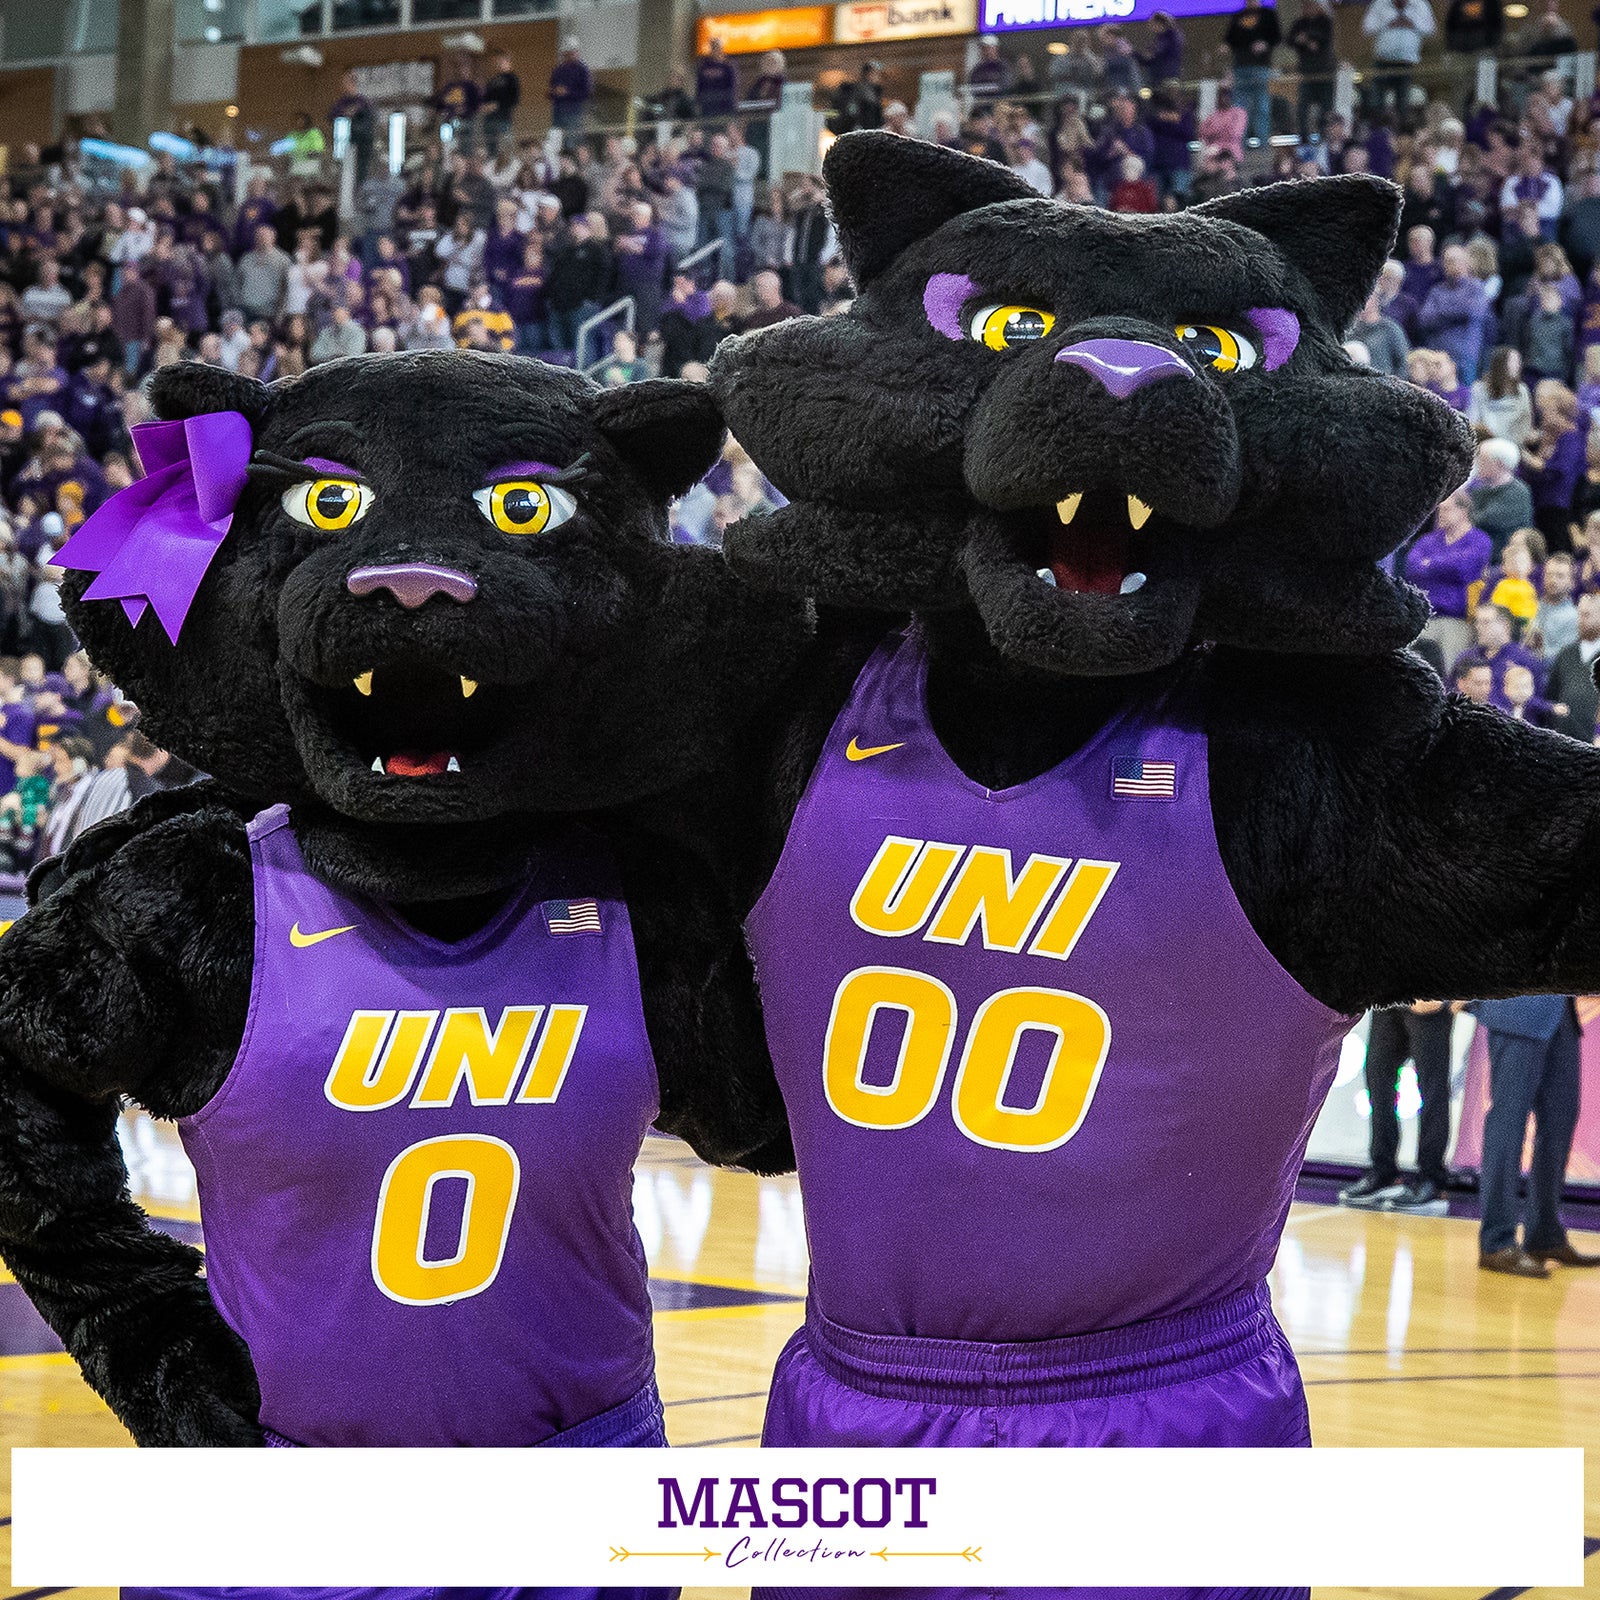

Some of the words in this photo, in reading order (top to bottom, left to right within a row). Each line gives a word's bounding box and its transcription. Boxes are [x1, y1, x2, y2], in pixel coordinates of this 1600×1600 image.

[888, 0, 955, 27] bank
[849, 834, 1121, 961] UNI
[324, 1004, 589, 1112] UNI
[822, 965, 1112, 1153] 00
[371, 1133, 521, 1306] 0
